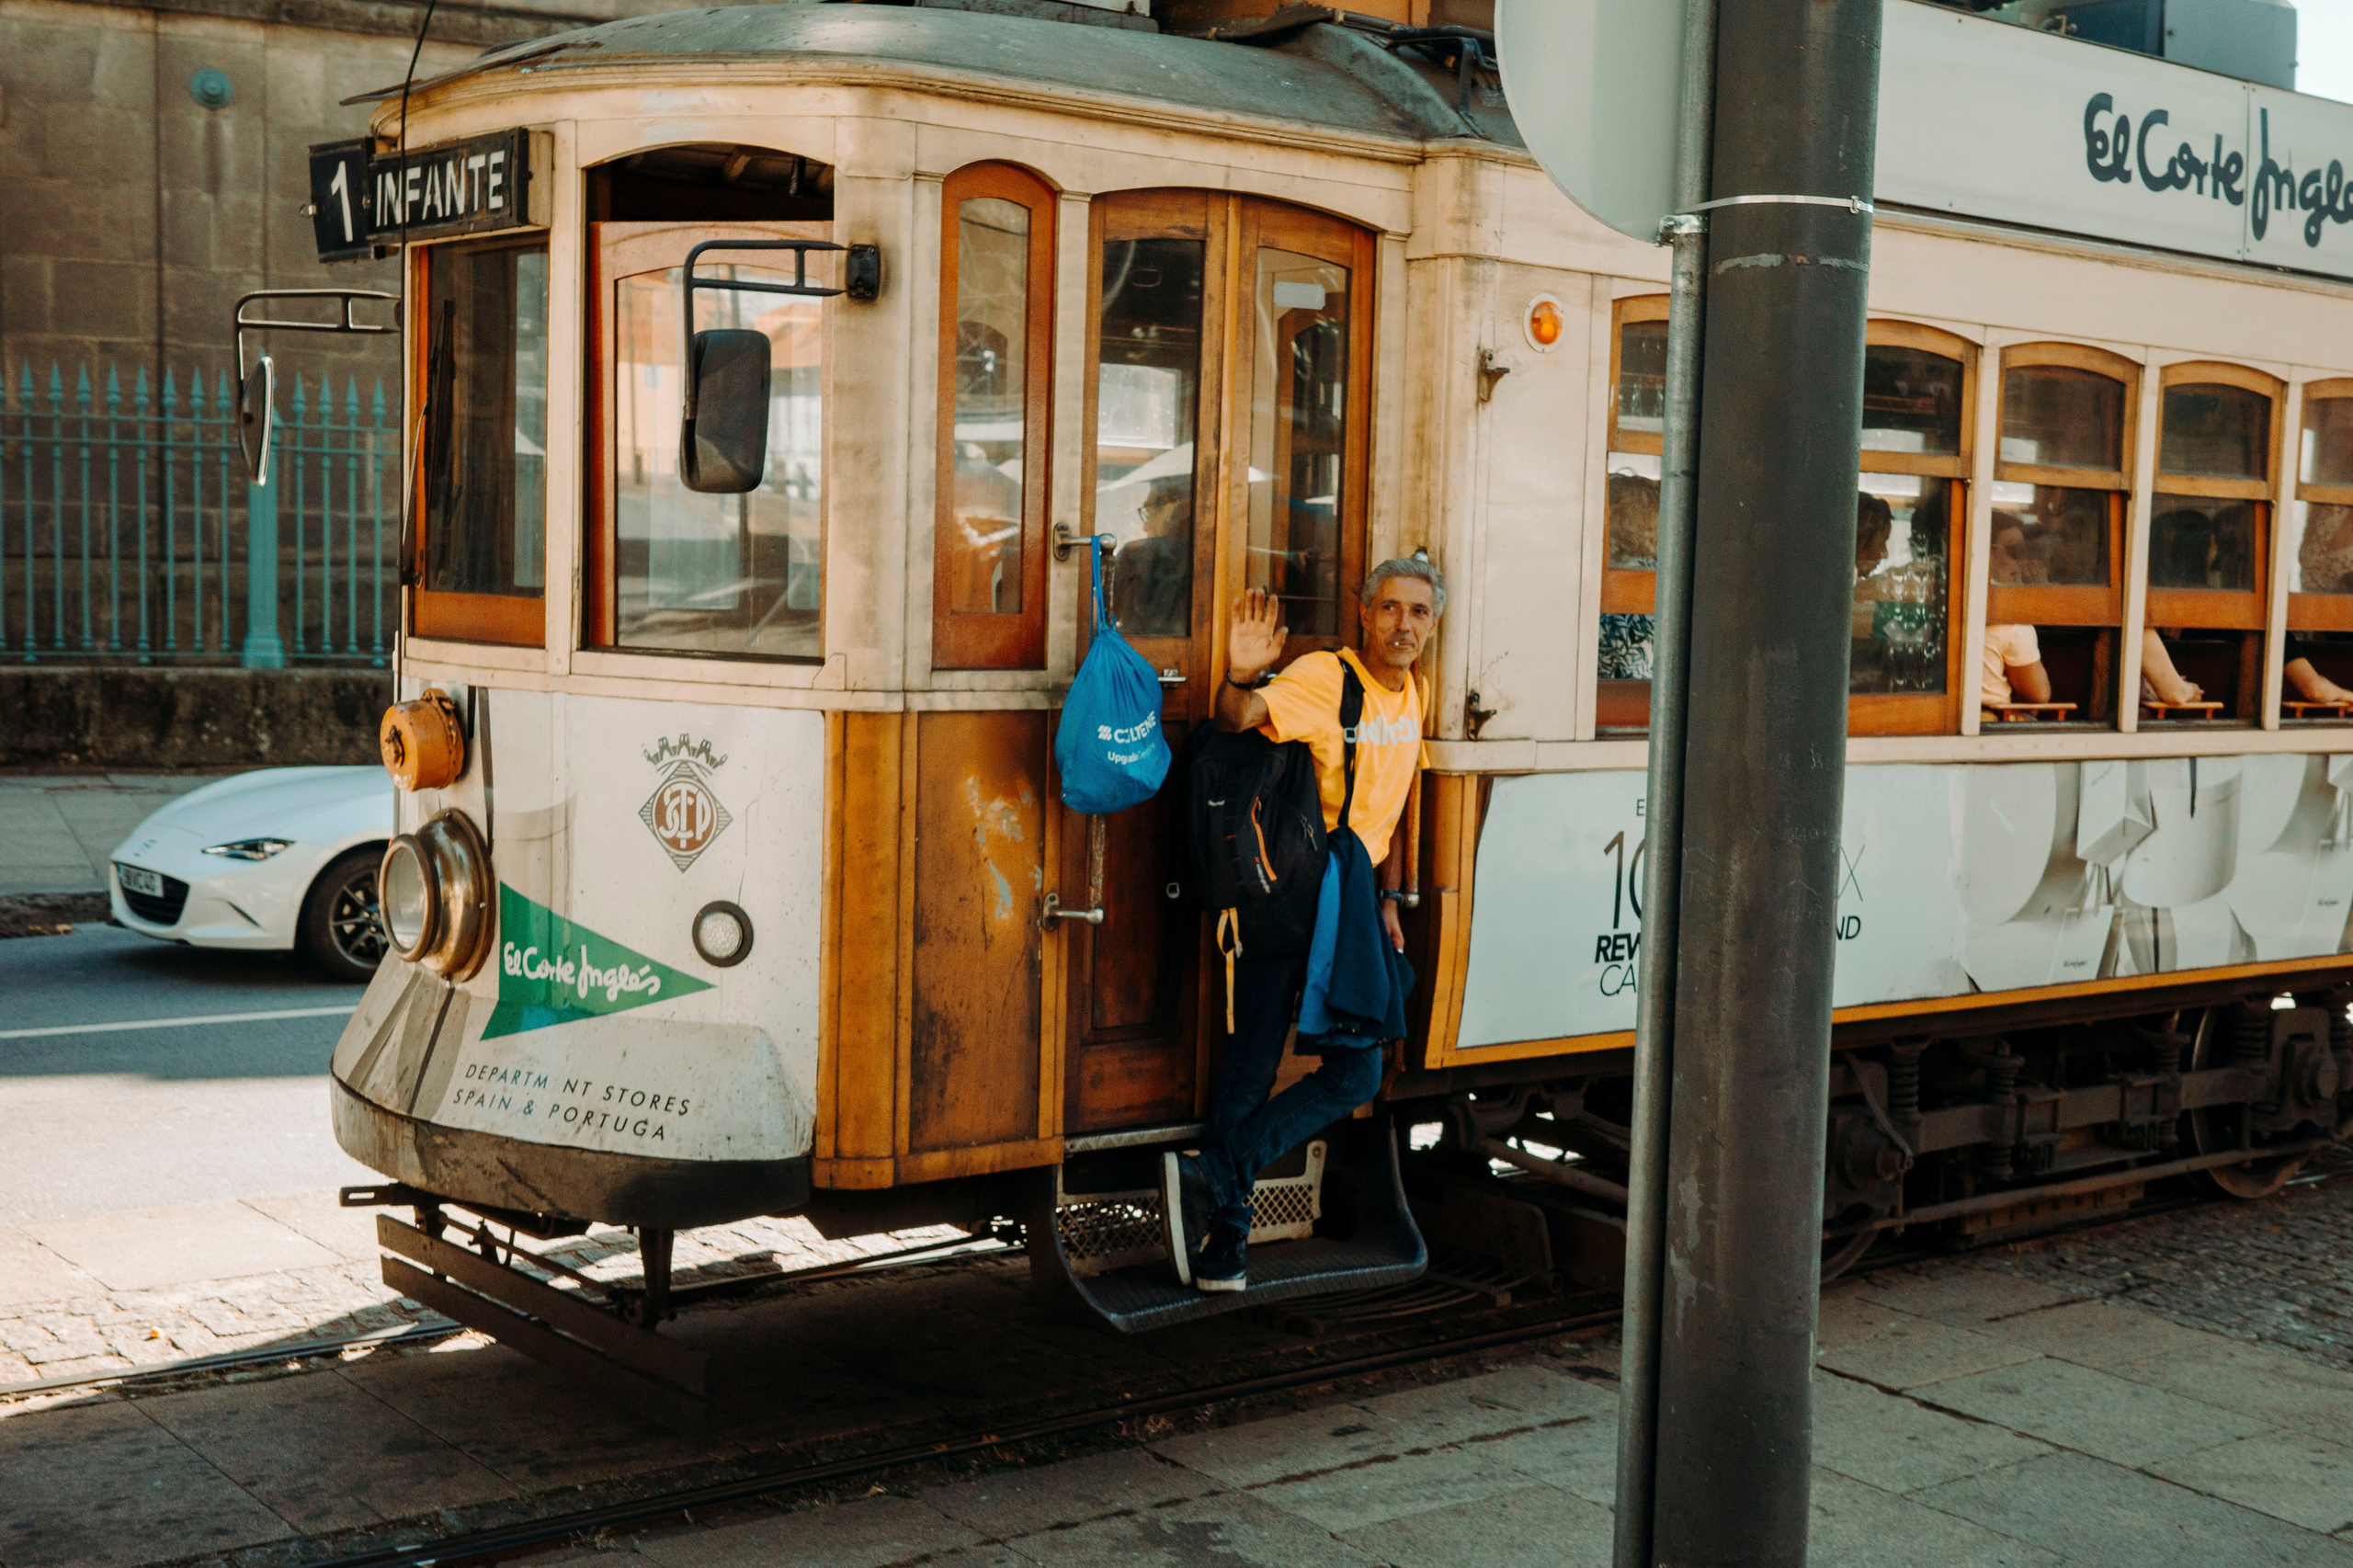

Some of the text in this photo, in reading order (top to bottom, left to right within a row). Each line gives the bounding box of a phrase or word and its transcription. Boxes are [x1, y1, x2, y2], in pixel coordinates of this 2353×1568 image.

[2084, 92, 2131, 184] El
[2137, 108, 2244, 206] Corte
[331, 160, 353, 243] 1
[376, 150, 505, 228] INFANTE
[504, 941, 661, 1002] El Corte Inglés
[453, 1089, 513, 1110] SPAIN
[522, 1099, 534, 1115] &
[603, 1085, 689, 1116] STORES
